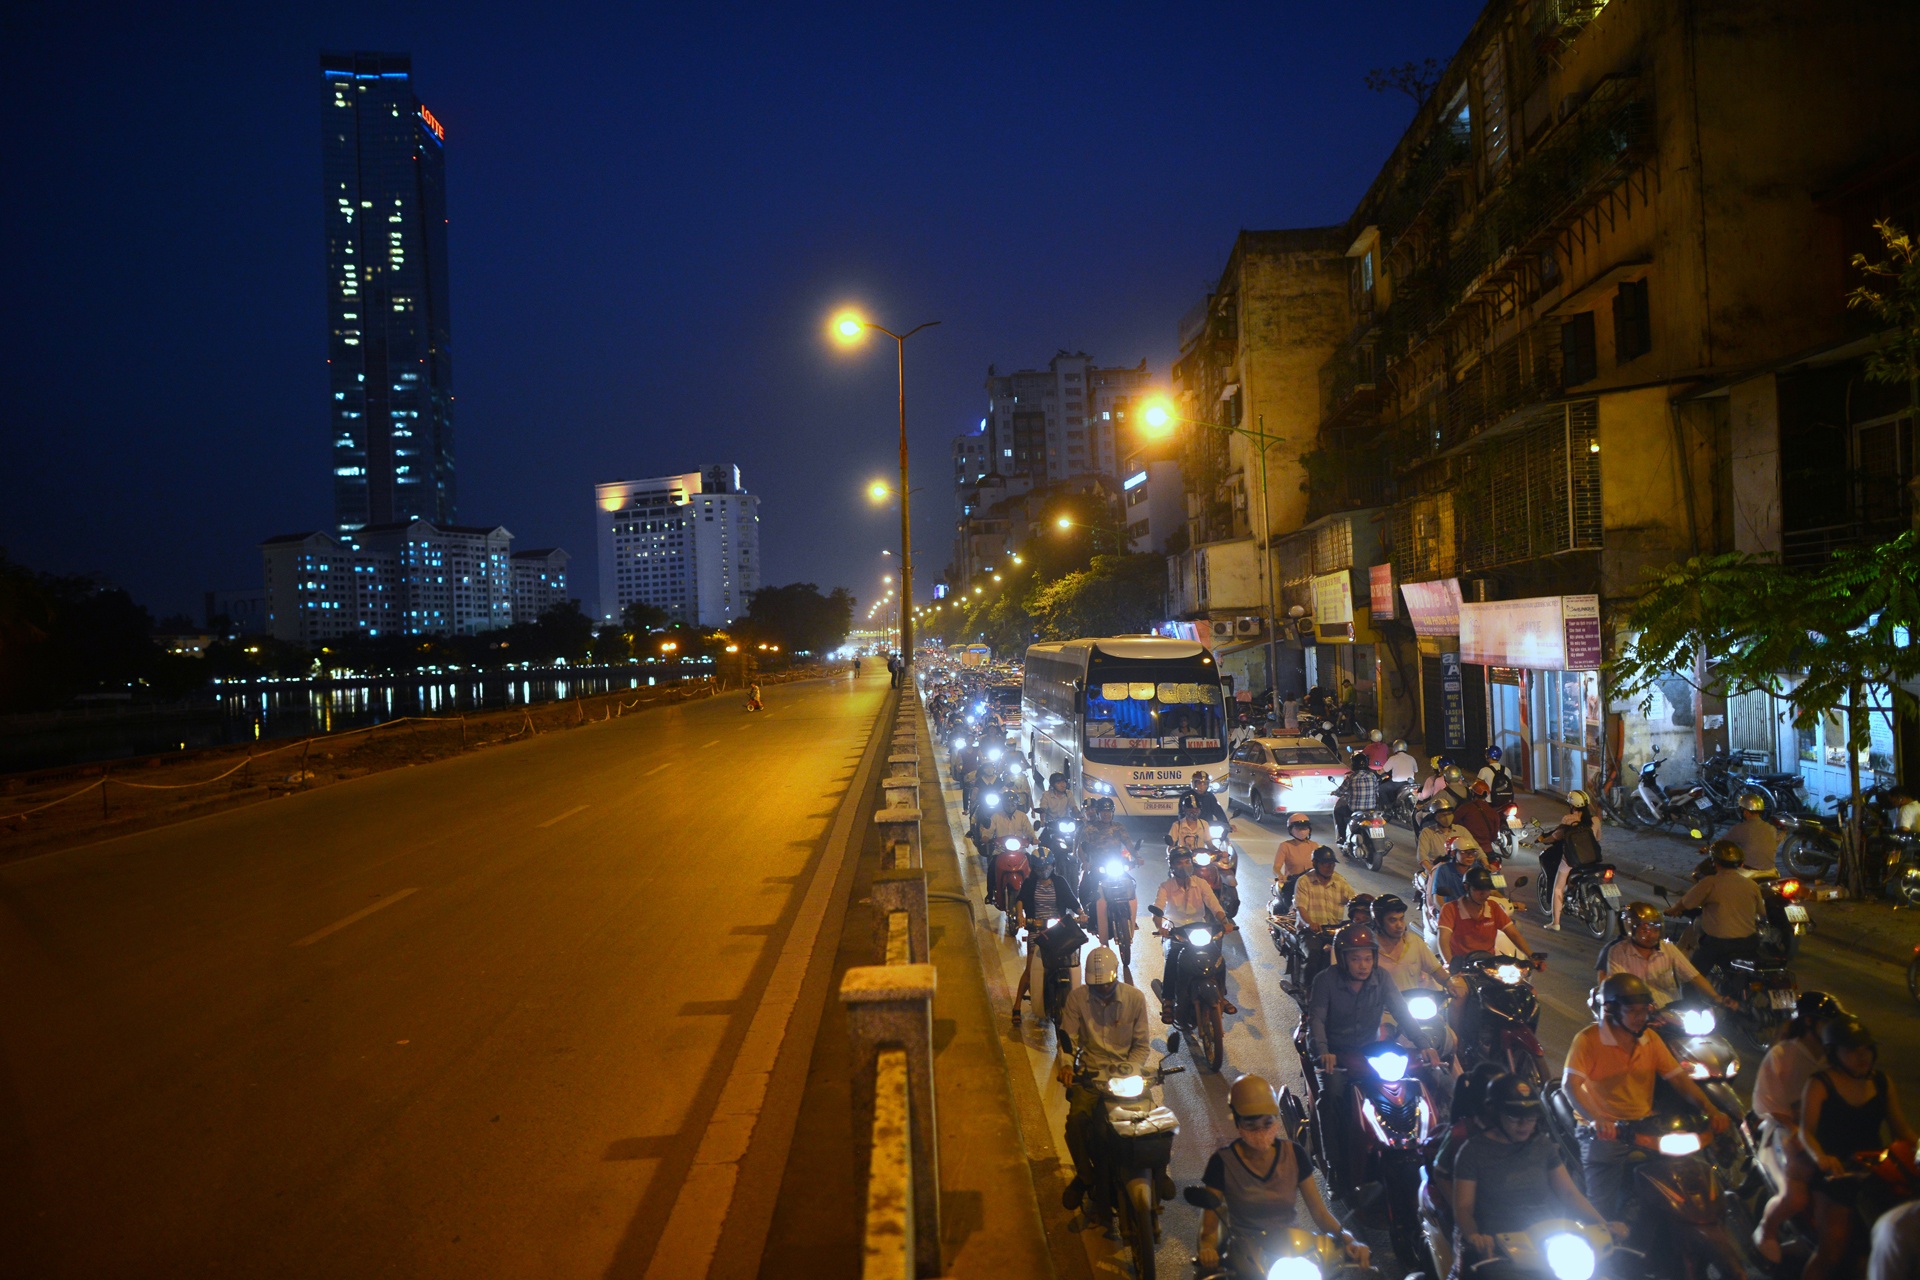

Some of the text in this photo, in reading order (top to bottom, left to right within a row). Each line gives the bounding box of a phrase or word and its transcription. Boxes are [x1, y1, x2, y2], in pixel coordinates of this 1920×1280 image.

[421, 104, 445, 141] LOTTE
[1443, 585, 1452, 607] A
[1187, 740, 1204, 748] KIM
[1133, 770, 1182, 780] SAM SUNG
